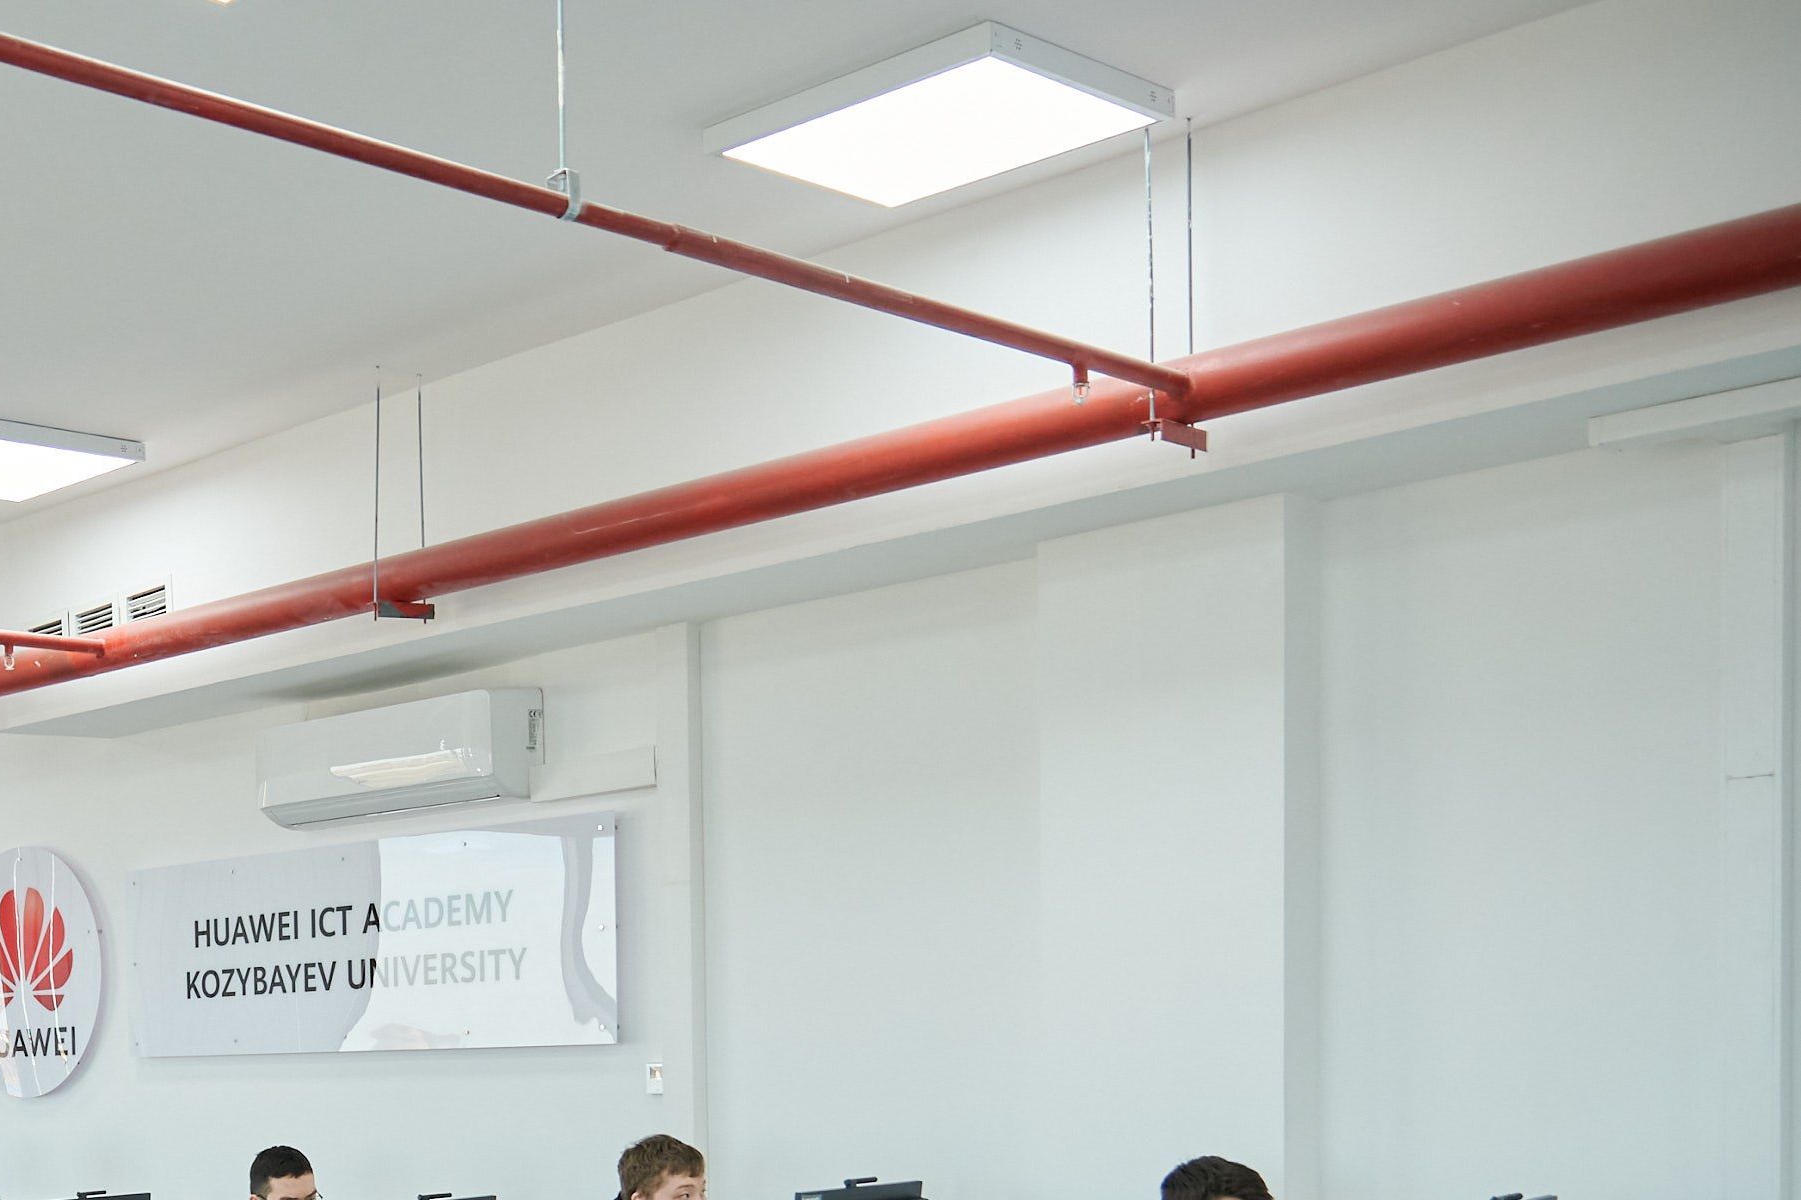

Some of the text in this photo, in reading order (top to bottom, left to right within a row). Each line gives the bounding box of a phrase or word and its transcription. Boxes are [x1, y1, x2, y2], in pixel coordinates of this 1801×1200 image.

[193, 889, 513, 948] HUAWEI ICT ACADEMY
[186, 947, 527, 999] KOZYBAYEV UNIVERSITY
